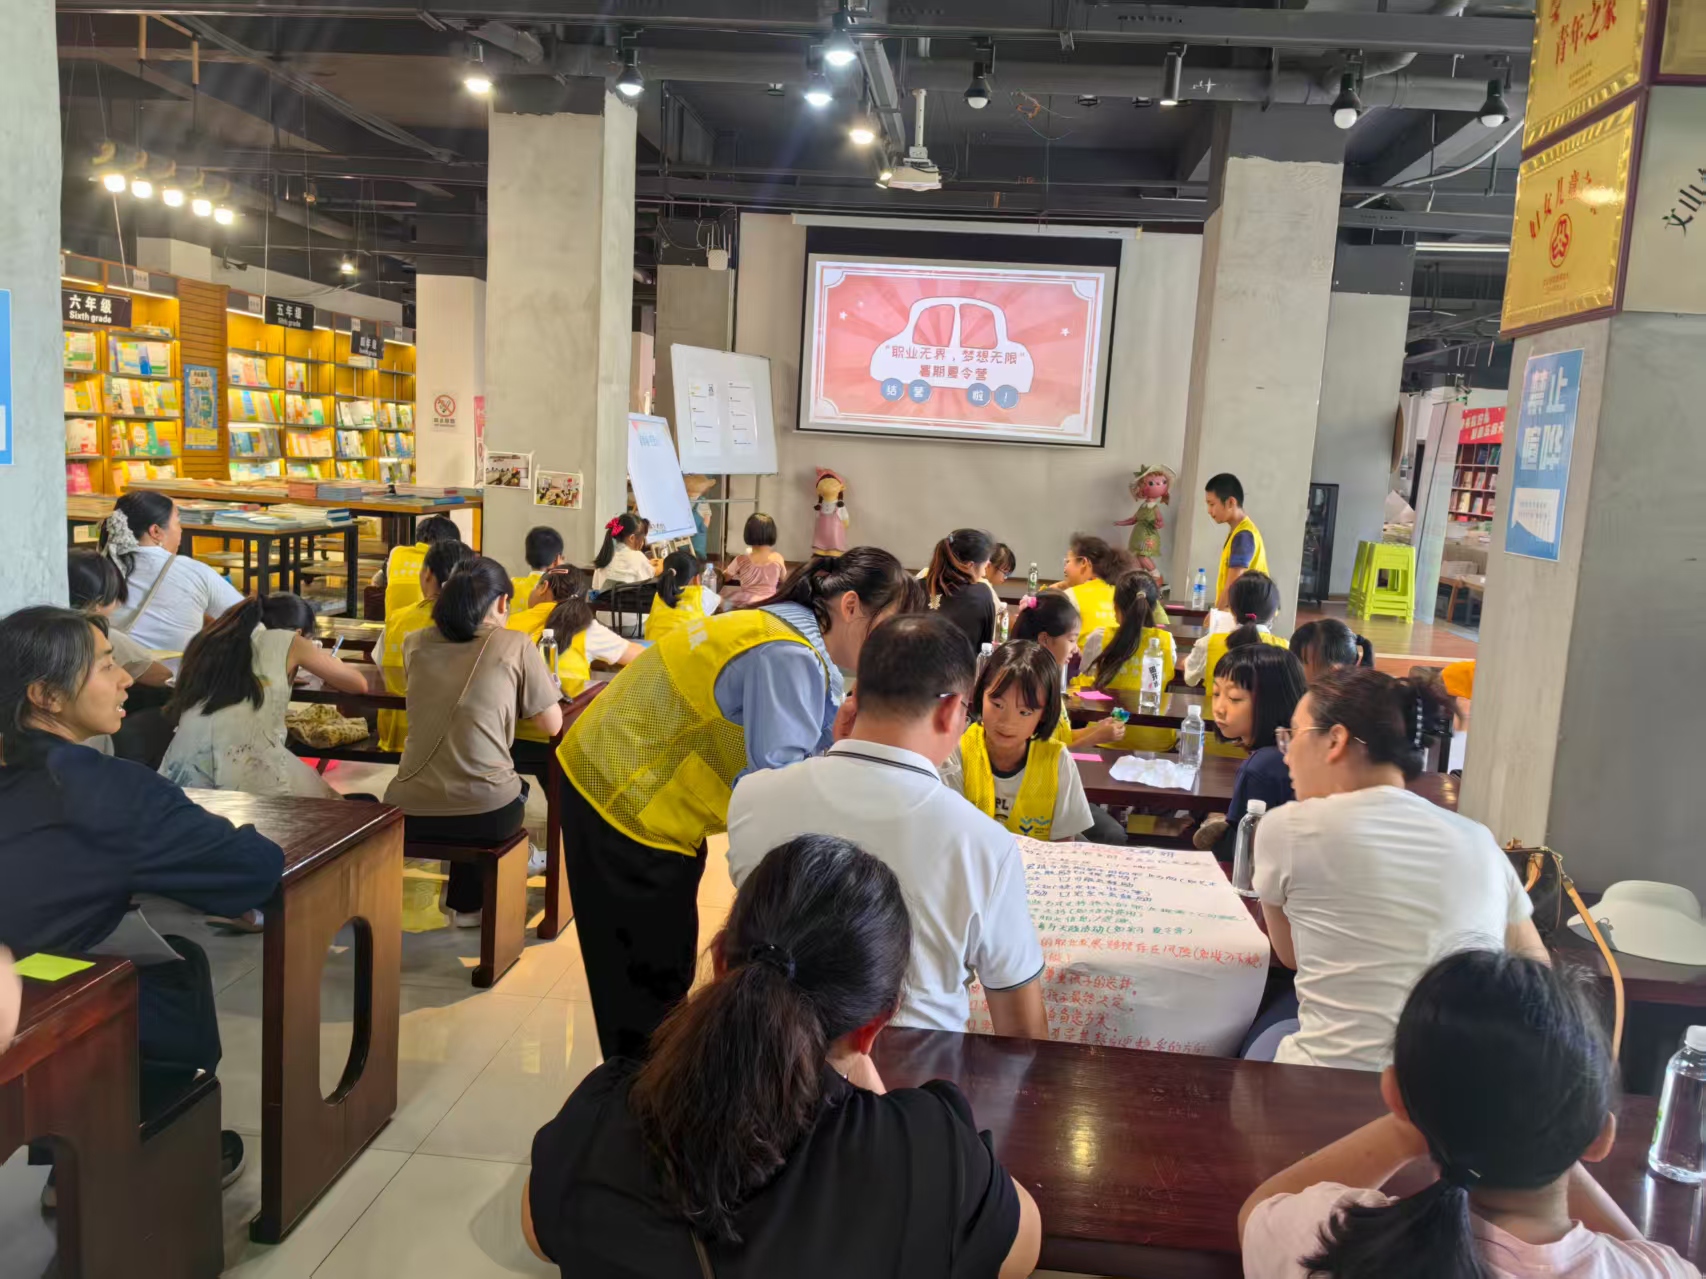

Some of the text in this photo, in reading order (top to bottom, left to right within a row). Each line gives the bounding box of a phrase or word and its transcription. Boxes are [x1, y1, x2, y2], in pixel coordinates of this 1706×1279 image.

[69, 293, 112, 314] 六年级
[276, 303, 302, 320] 五年级
[69, 311, 112, 325] Sixth grade
[919, 364, 988, 381] 暑期夏令营
[1527, 366, 1569, 416] 禁止
[1520, 423, 1565, 471] 喧哗
